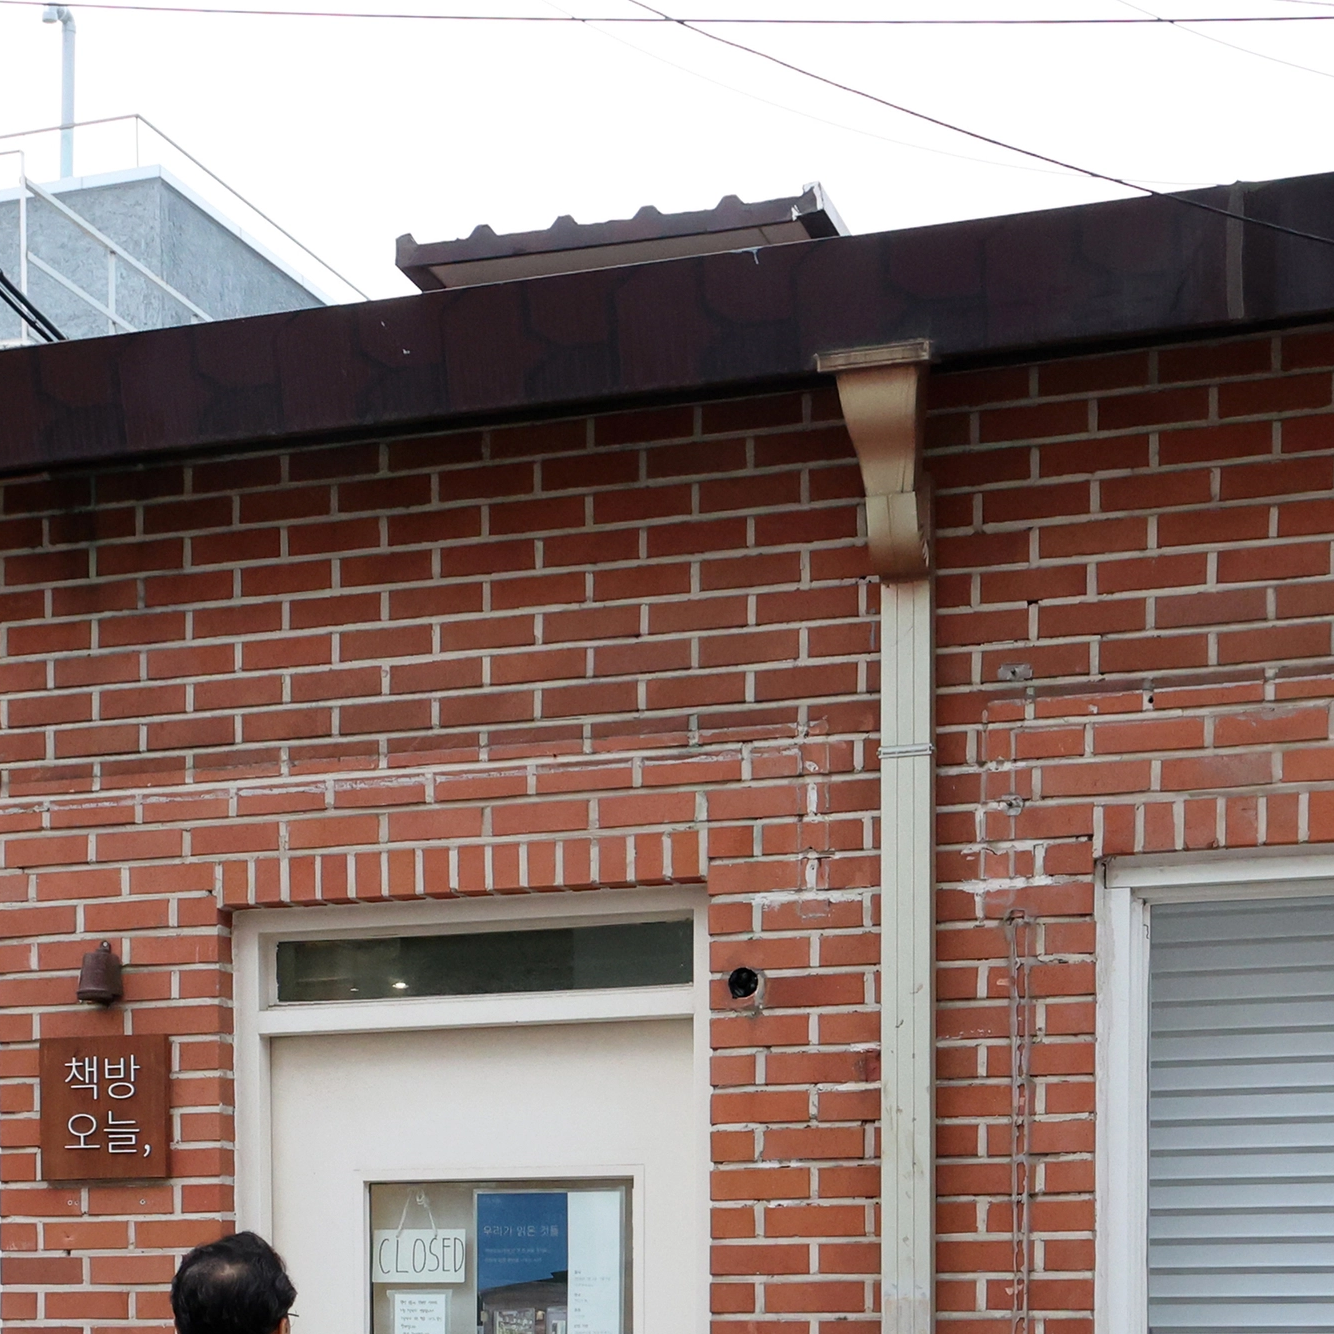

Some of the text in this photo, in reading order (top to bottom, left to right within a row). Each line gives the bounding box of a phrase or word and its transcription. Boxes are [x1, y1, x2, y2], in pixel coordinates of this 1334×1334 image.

[64, 1054, 141, 1100] 책방
[64, 1110, 152, 1158] 오늘,
[483, 1225, 513, 1237] 우리가
[516, 1225, 536, 1237] 읽은
[378, 1237, 465, 1275] CLOSED
